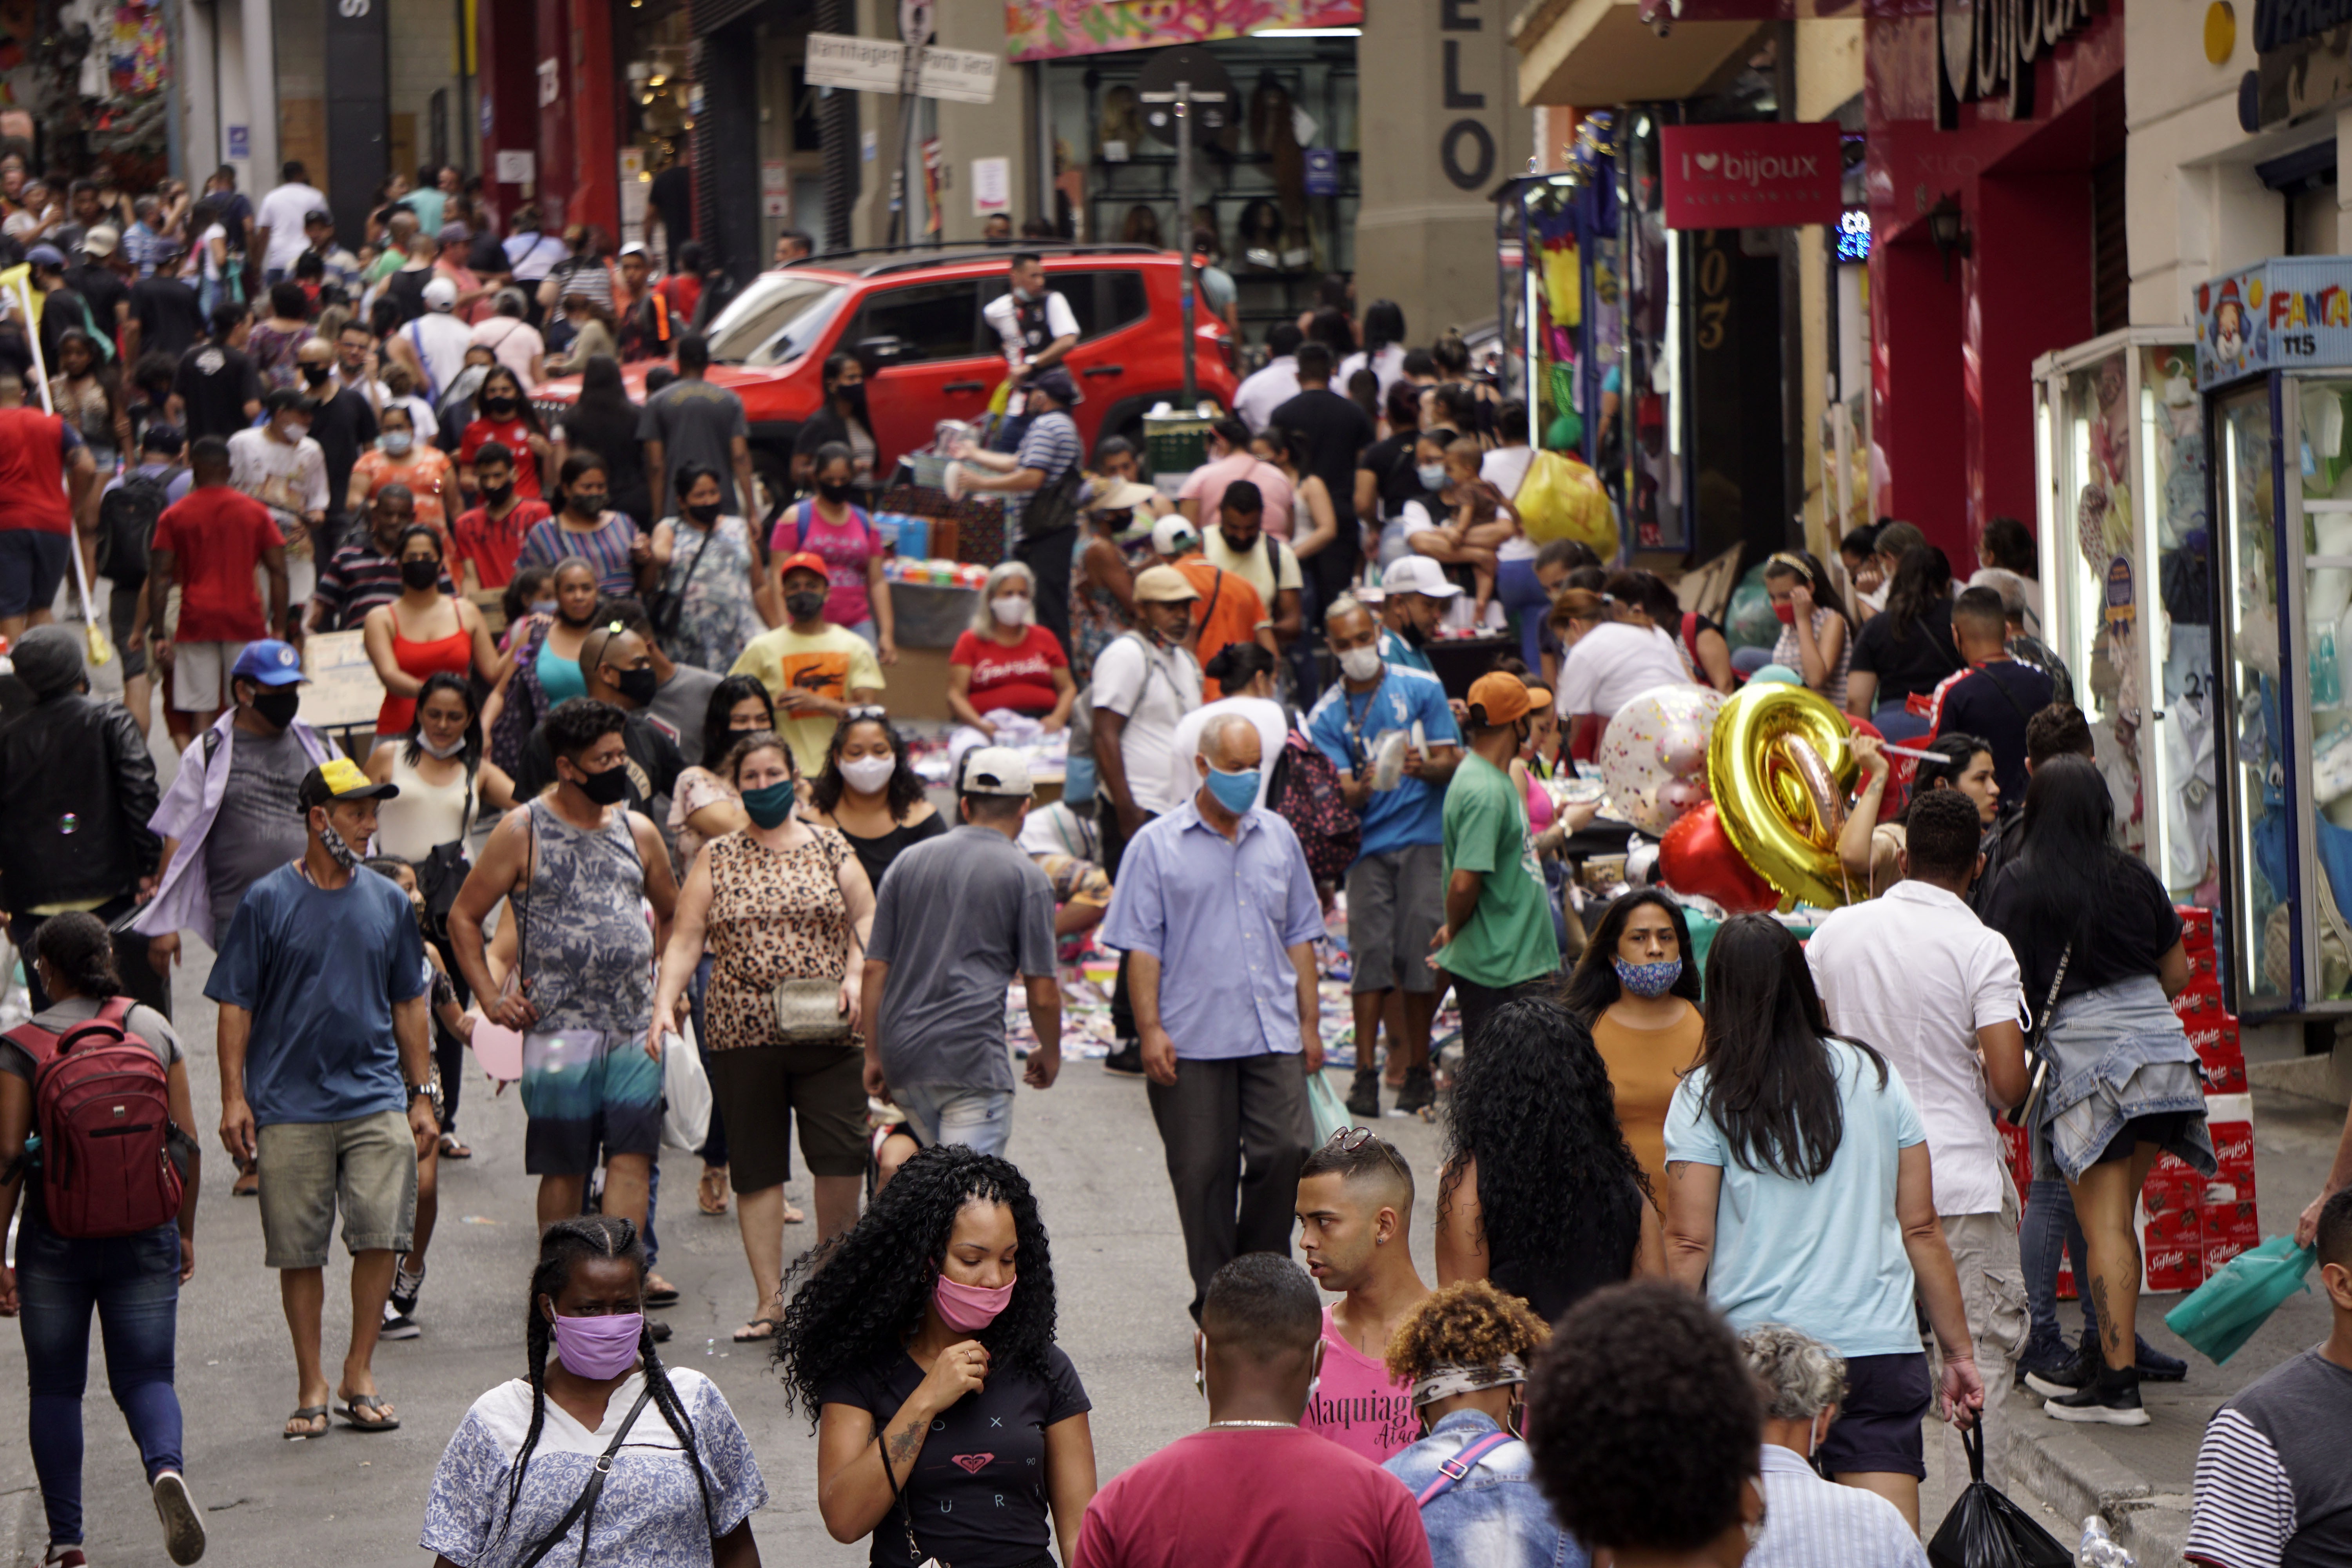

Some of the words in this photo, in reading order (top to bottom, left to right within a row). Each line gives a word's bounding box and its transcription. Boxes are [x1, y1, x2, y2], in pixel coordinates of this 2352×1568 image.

[1723, 151, 1818, 187] bijoux
[2268, 285, 2352, 331] FANTA
[2283, 334, 2316, 356] 115
[2047, 969, 2065, 1006] FOREVER
[2149, 1250, 2184, 1273] Suflair
[2206, 1242, 2240, 1265] Suflair
[1026, 1457, 1036, 1466] 90
